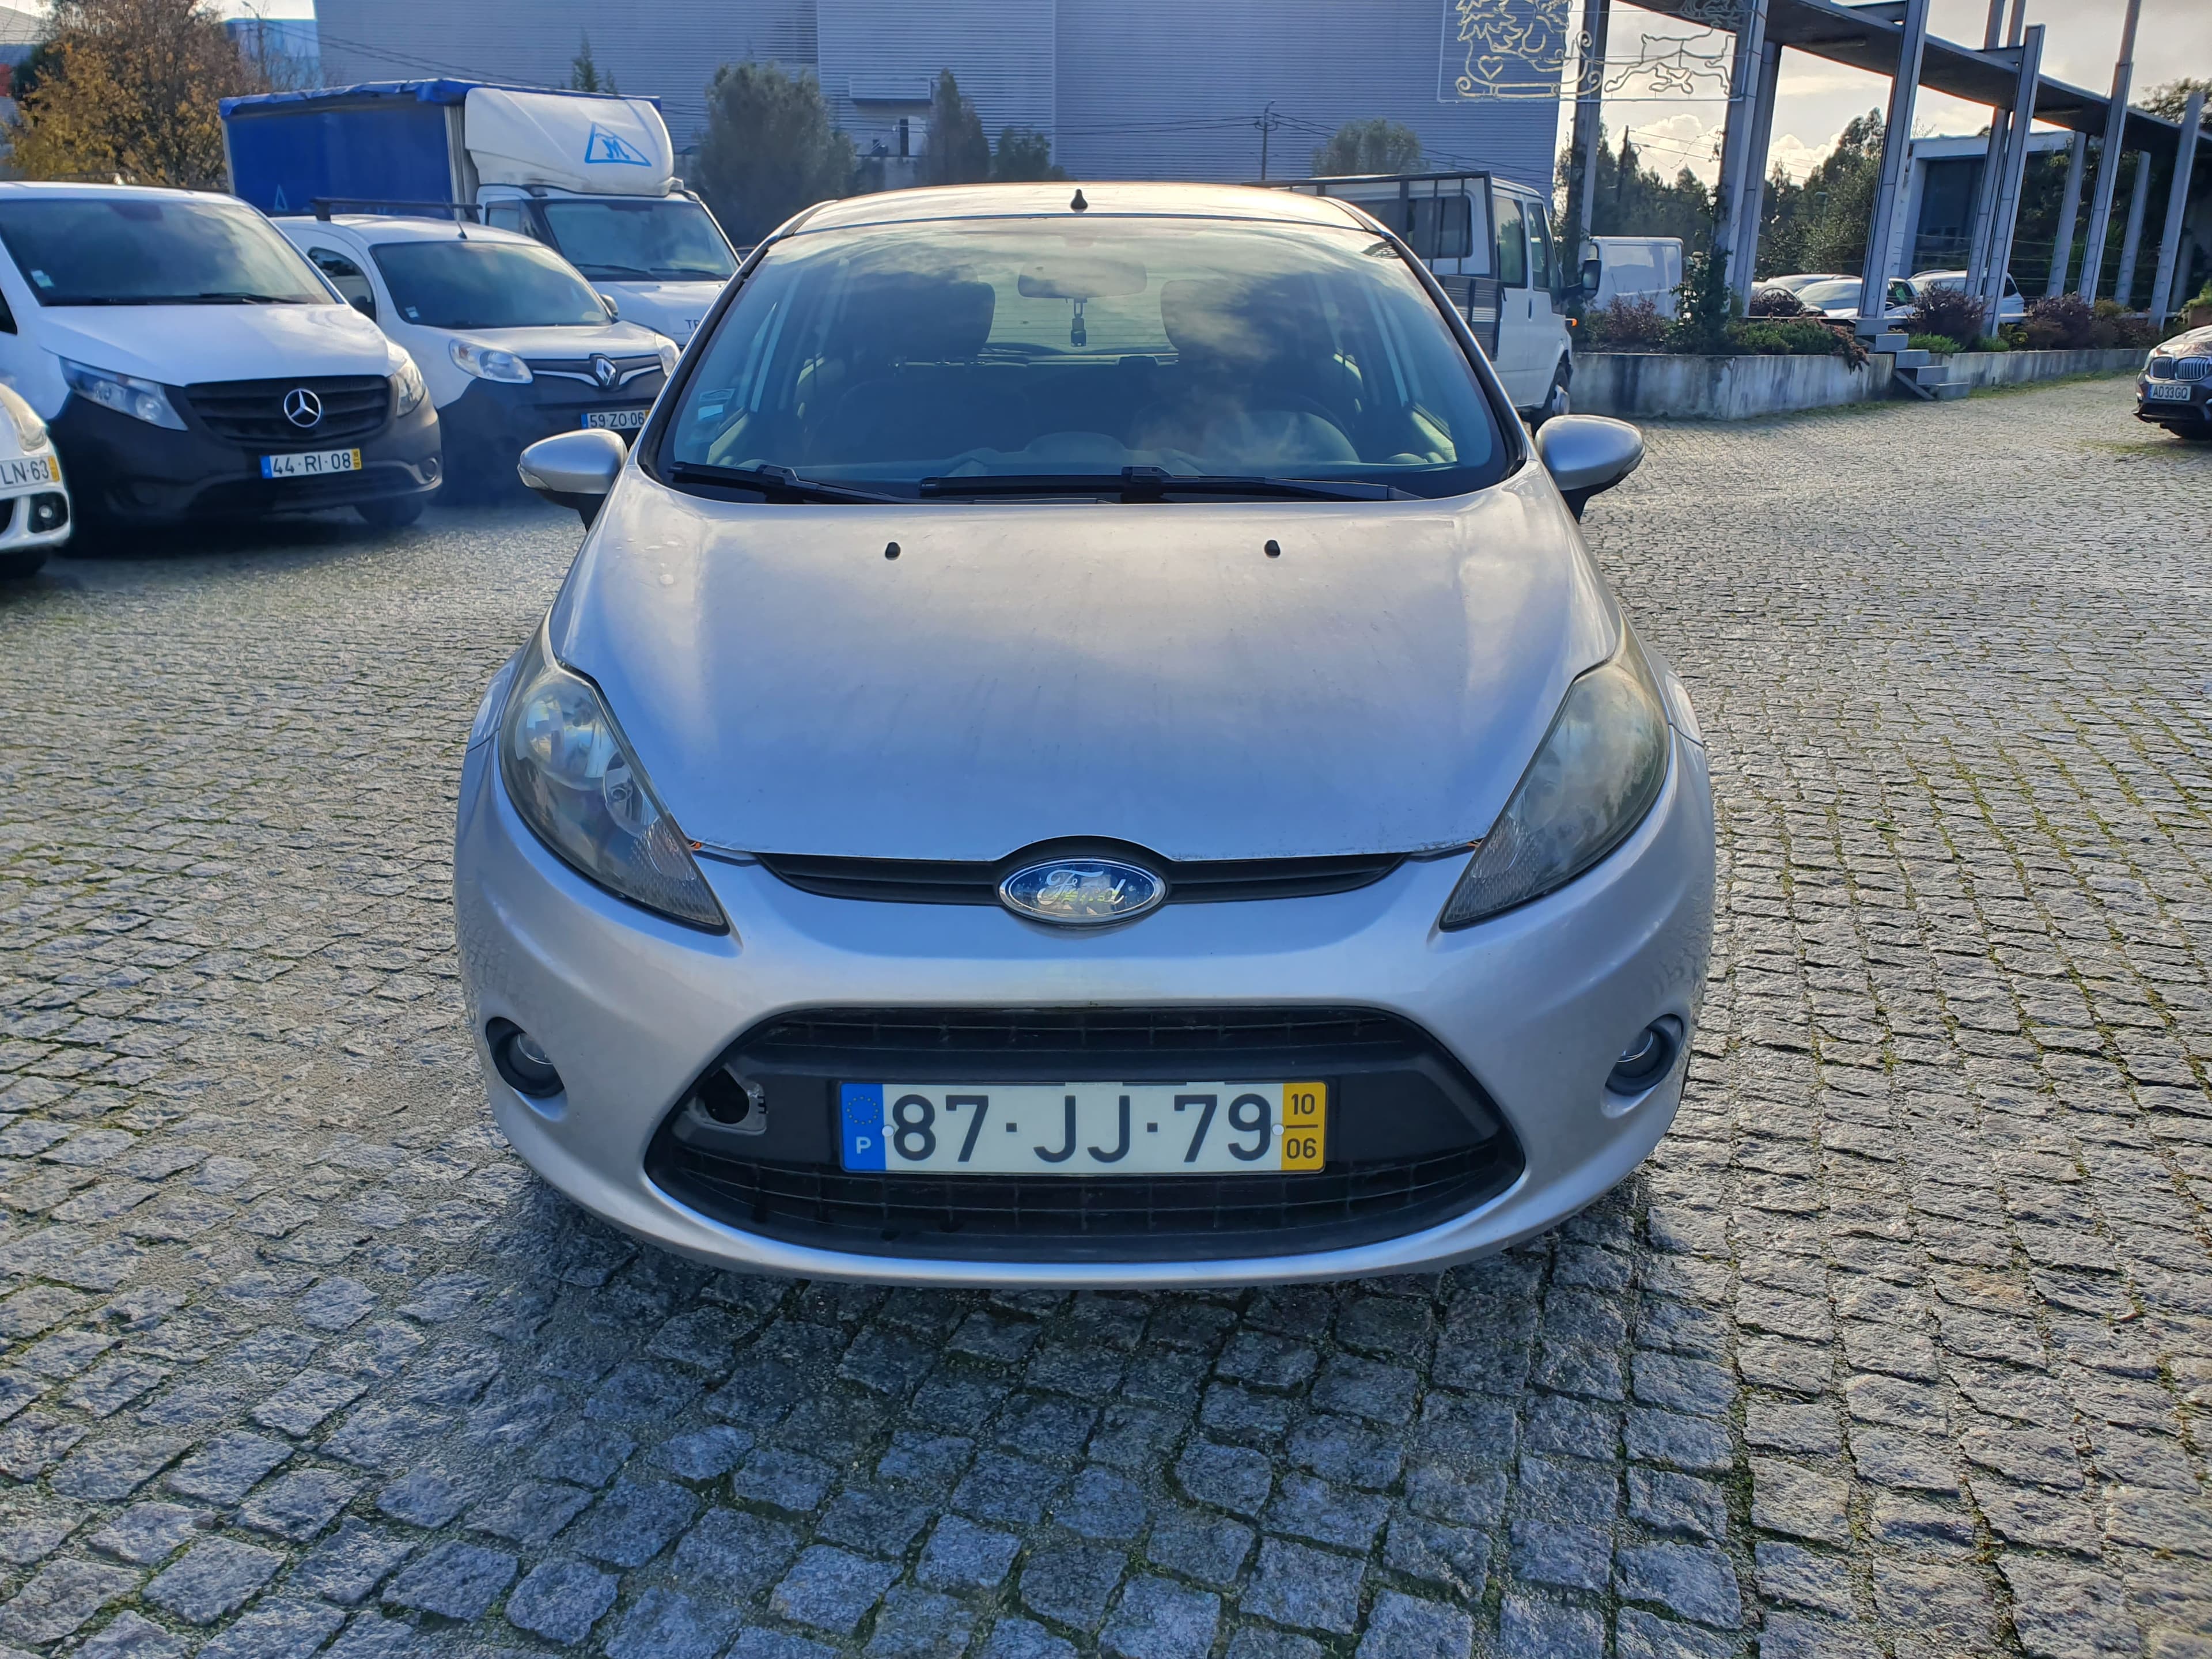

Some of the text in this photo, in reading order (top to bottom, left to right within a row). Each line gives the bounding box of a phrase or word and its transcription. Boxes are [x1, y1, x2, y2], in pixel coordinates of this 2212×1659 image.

[1037, 869, 1127, 905] Ford
[1291, 1093, 1315, 1116] 10
[856, 1137, 872, 1154] P
[1286, 1138, 1317, 1160] 06
